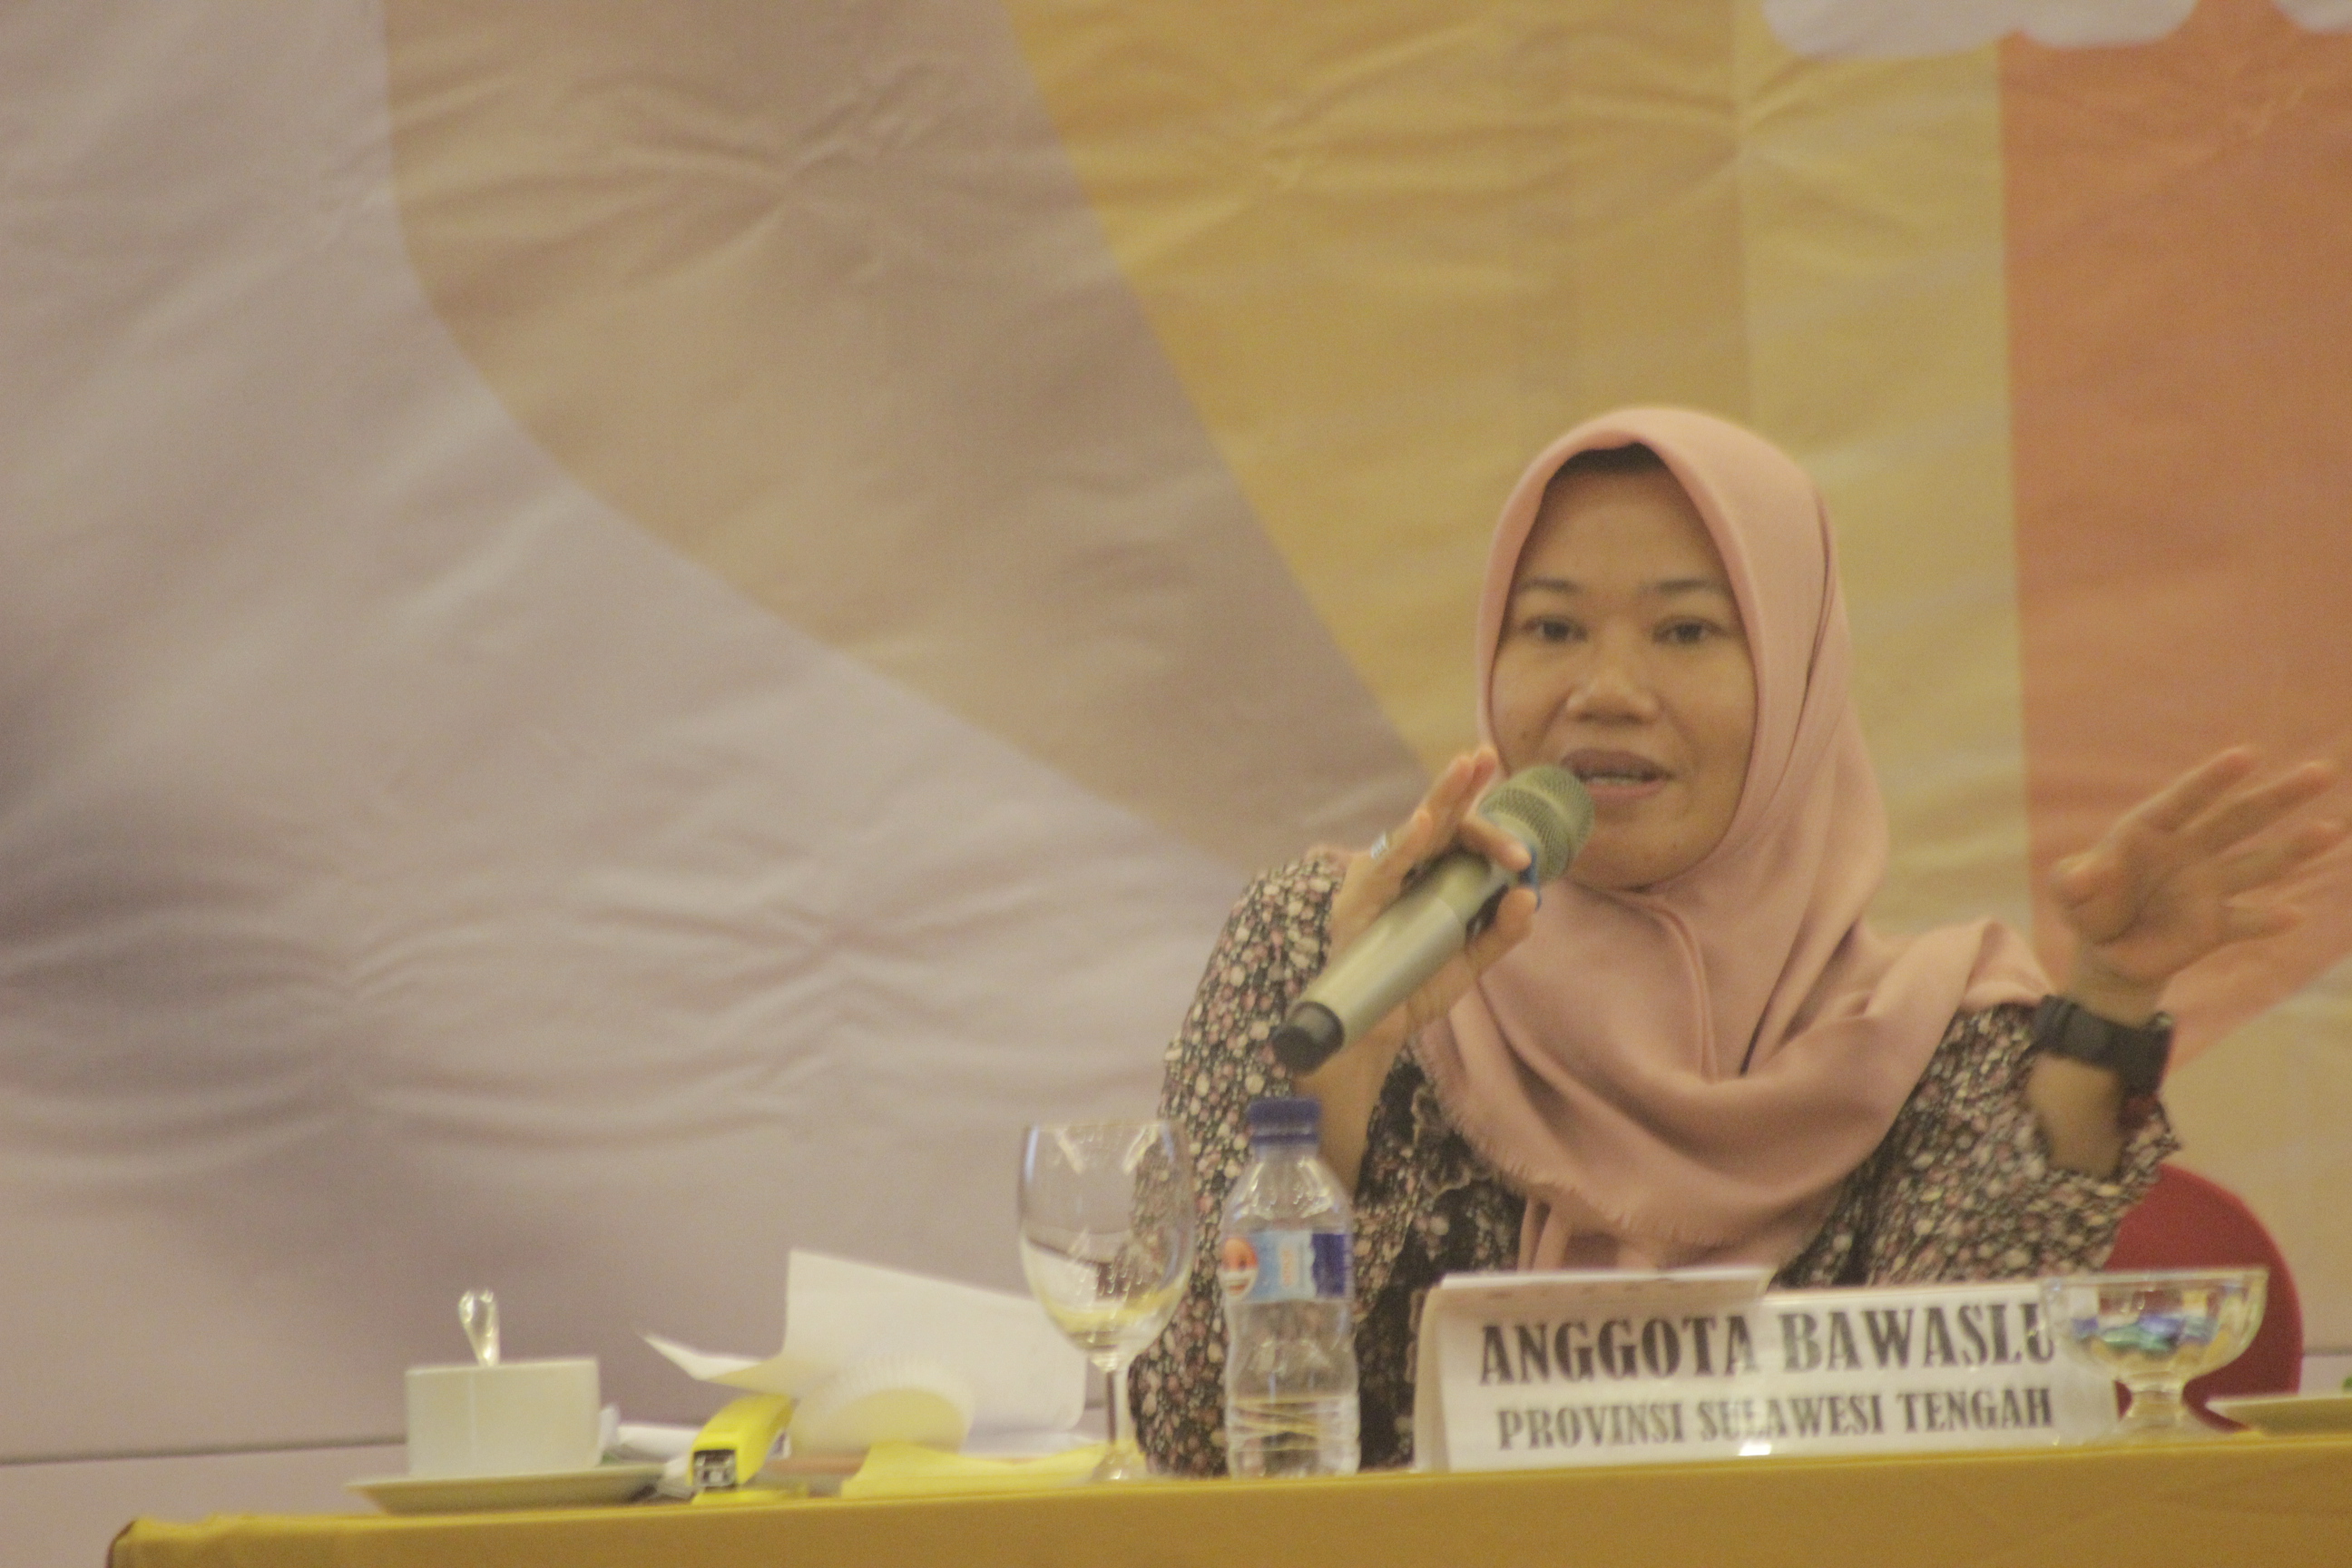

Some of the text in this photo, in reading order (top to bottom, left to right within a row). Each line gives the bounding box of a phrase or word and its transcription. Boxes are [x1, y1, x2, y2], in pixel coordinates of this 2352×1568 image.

[1481, 1303, 2054, 1385] ANGGOTA BAWASLU
[1497, 1403, 1683, 1450] PROVINSI
[1897, 1388, 2053, 1431] TENGAH
